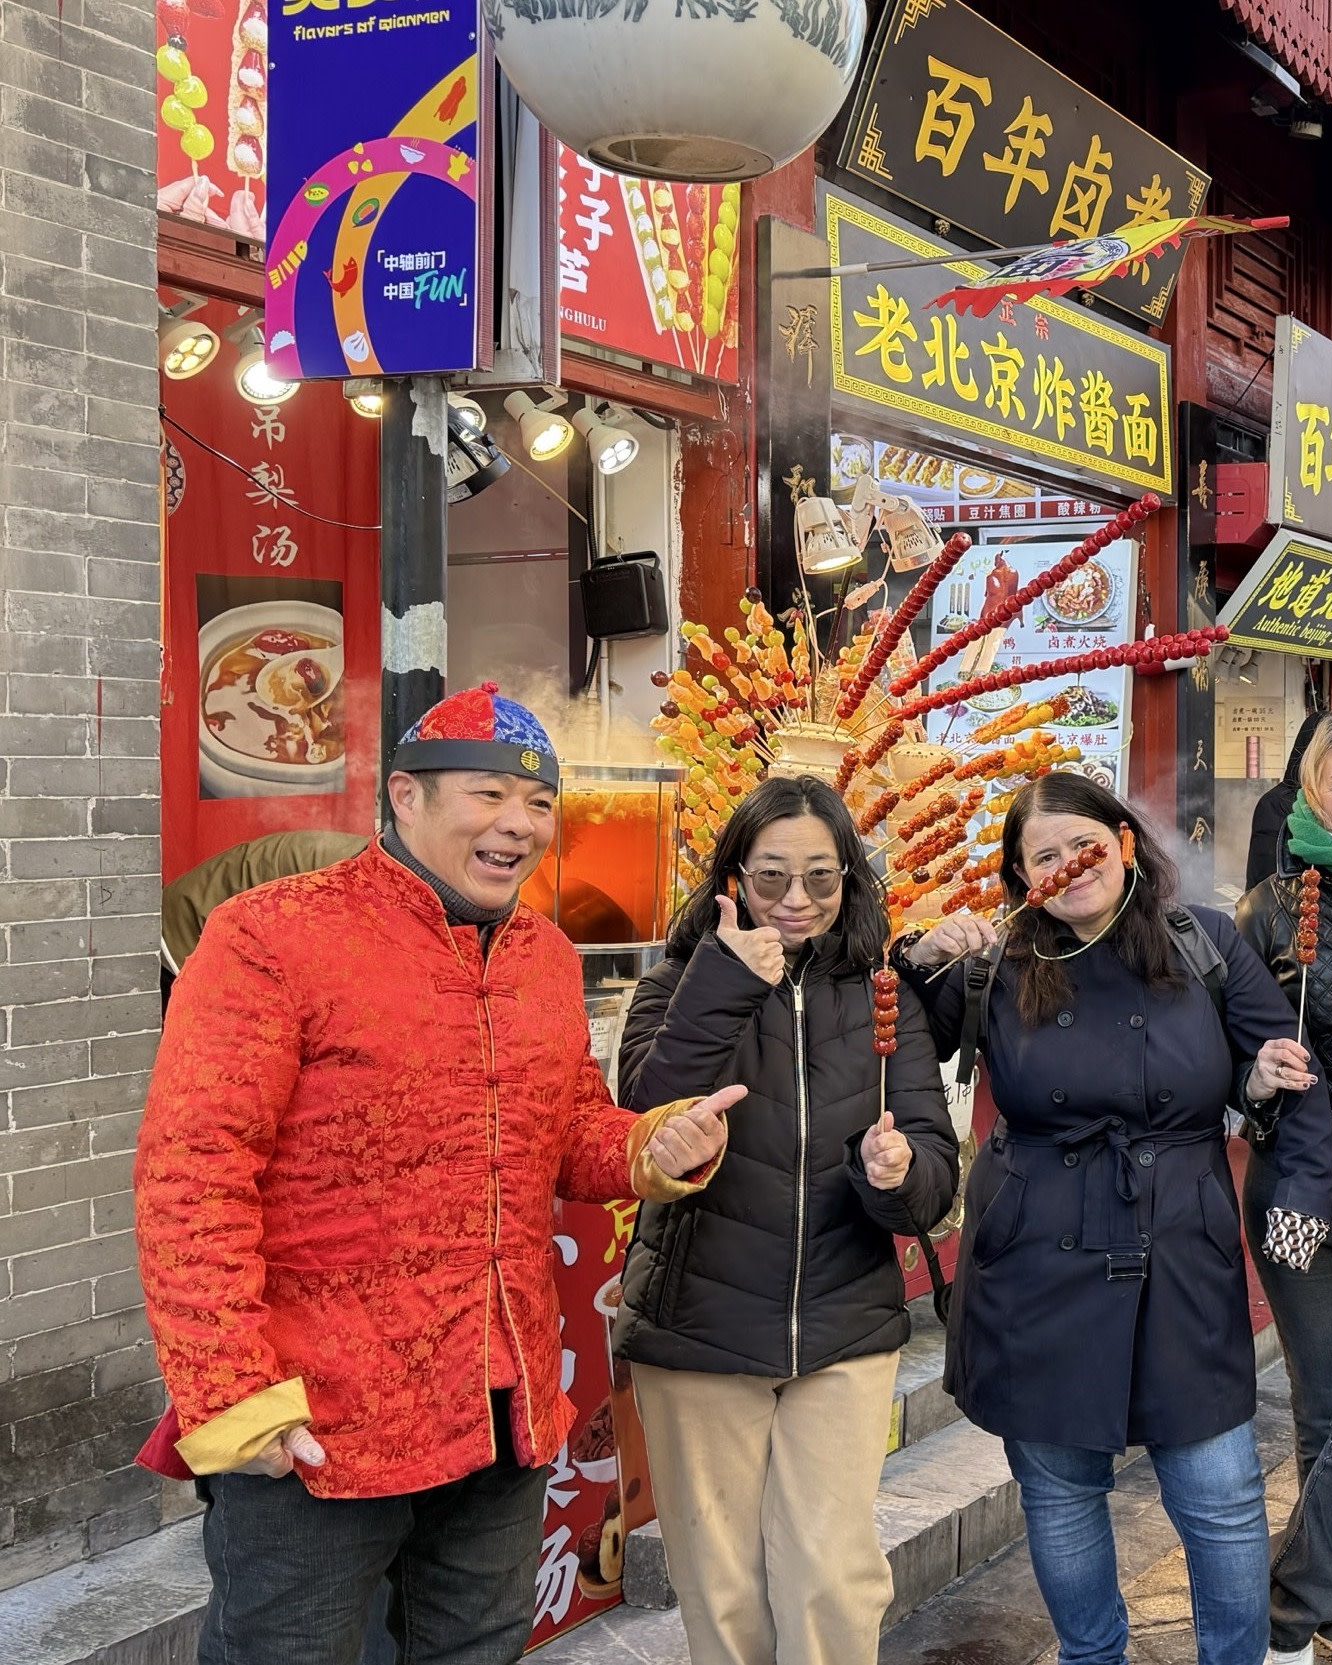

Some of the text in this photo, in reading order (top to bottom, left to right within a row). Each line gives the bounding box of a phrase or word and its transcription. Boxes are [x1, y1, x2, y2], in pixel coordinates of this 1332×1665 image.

[999, 299, 1050, 340] 正宗
[1048, 635, 1107, 649] 卤煮火烧
[1253, 614, 1301, 637] Authentic
[1301, 622, 1331, 646] beijing
